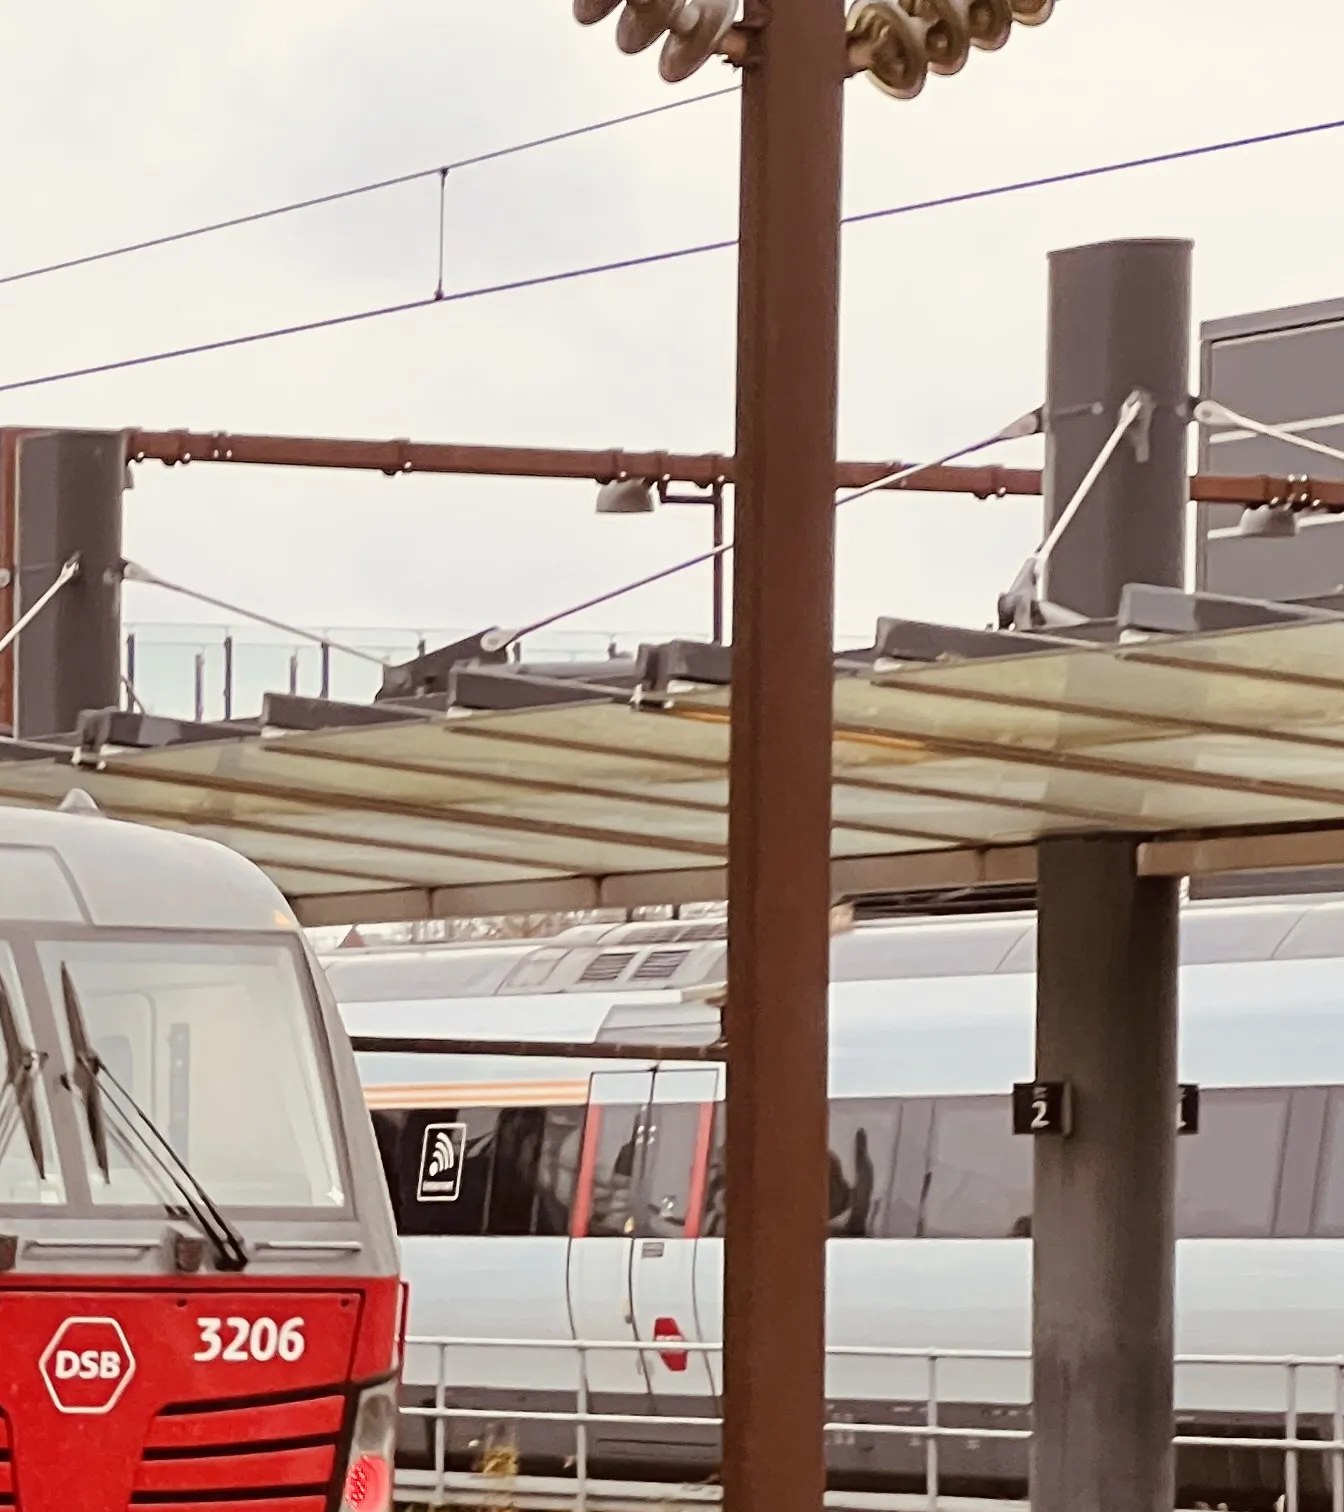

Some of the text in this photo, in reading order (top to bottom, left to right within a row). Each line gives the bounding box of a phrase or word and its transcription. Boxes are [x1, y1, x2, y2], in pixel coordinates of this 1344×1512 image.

[1031, 1100, 1050, 1129] 2
[192, 1317, 305, 1362] 3206
[55, 1350, 121, 1379] DSB
